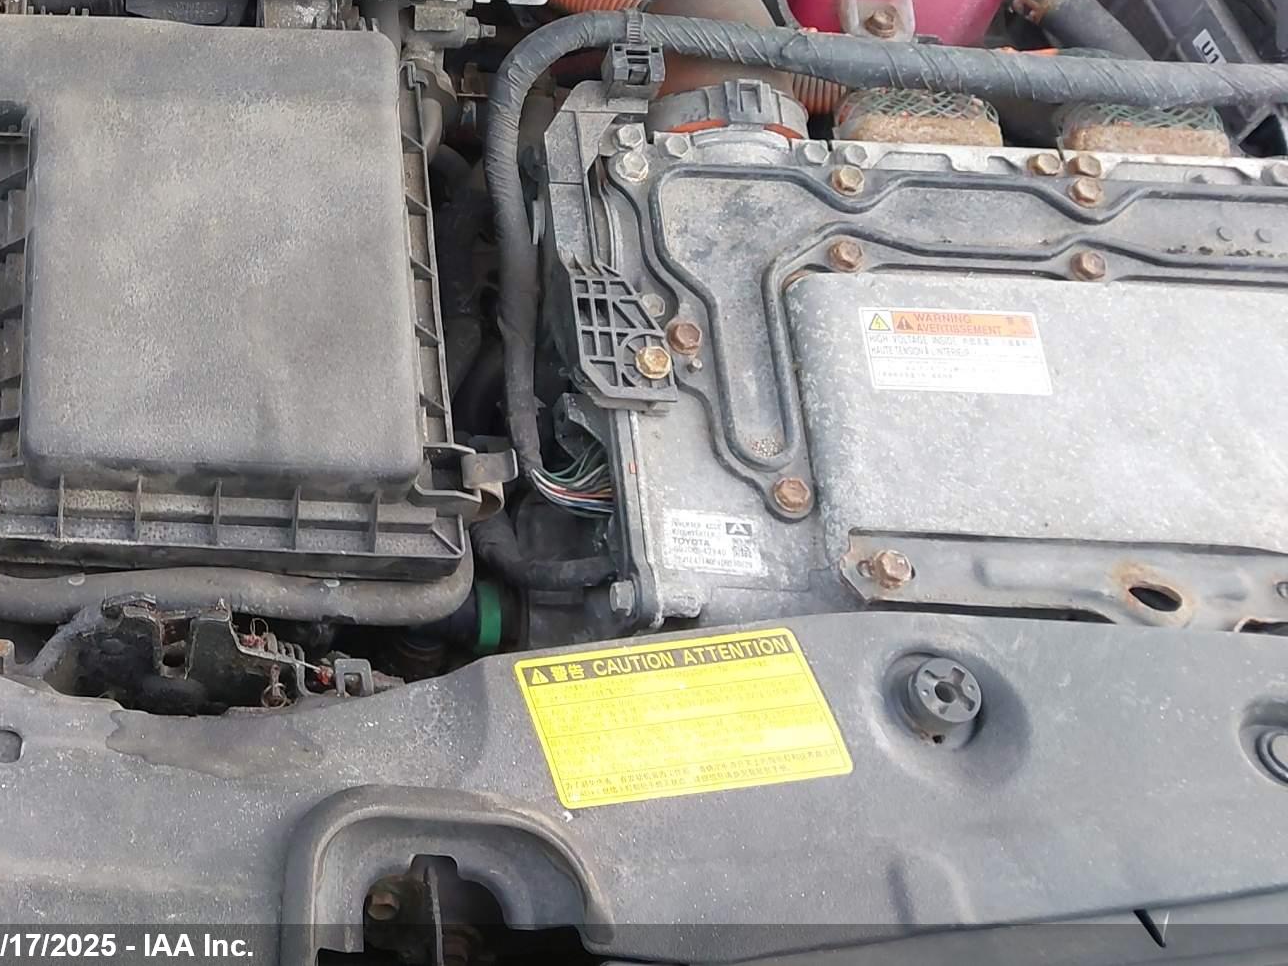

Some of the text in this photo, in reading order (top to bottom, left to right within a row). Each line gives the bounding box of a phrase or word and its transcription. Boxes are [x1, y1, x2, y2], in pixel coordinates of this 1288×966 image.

[914, 313, 972, 325] WARNING
[916, 324, 1002, 337] AVERTISSEMENT
[673, 536, 711, 547] TOYOTA
[551, 636, 790, 682] 警告 CAUTION ATTENTION
